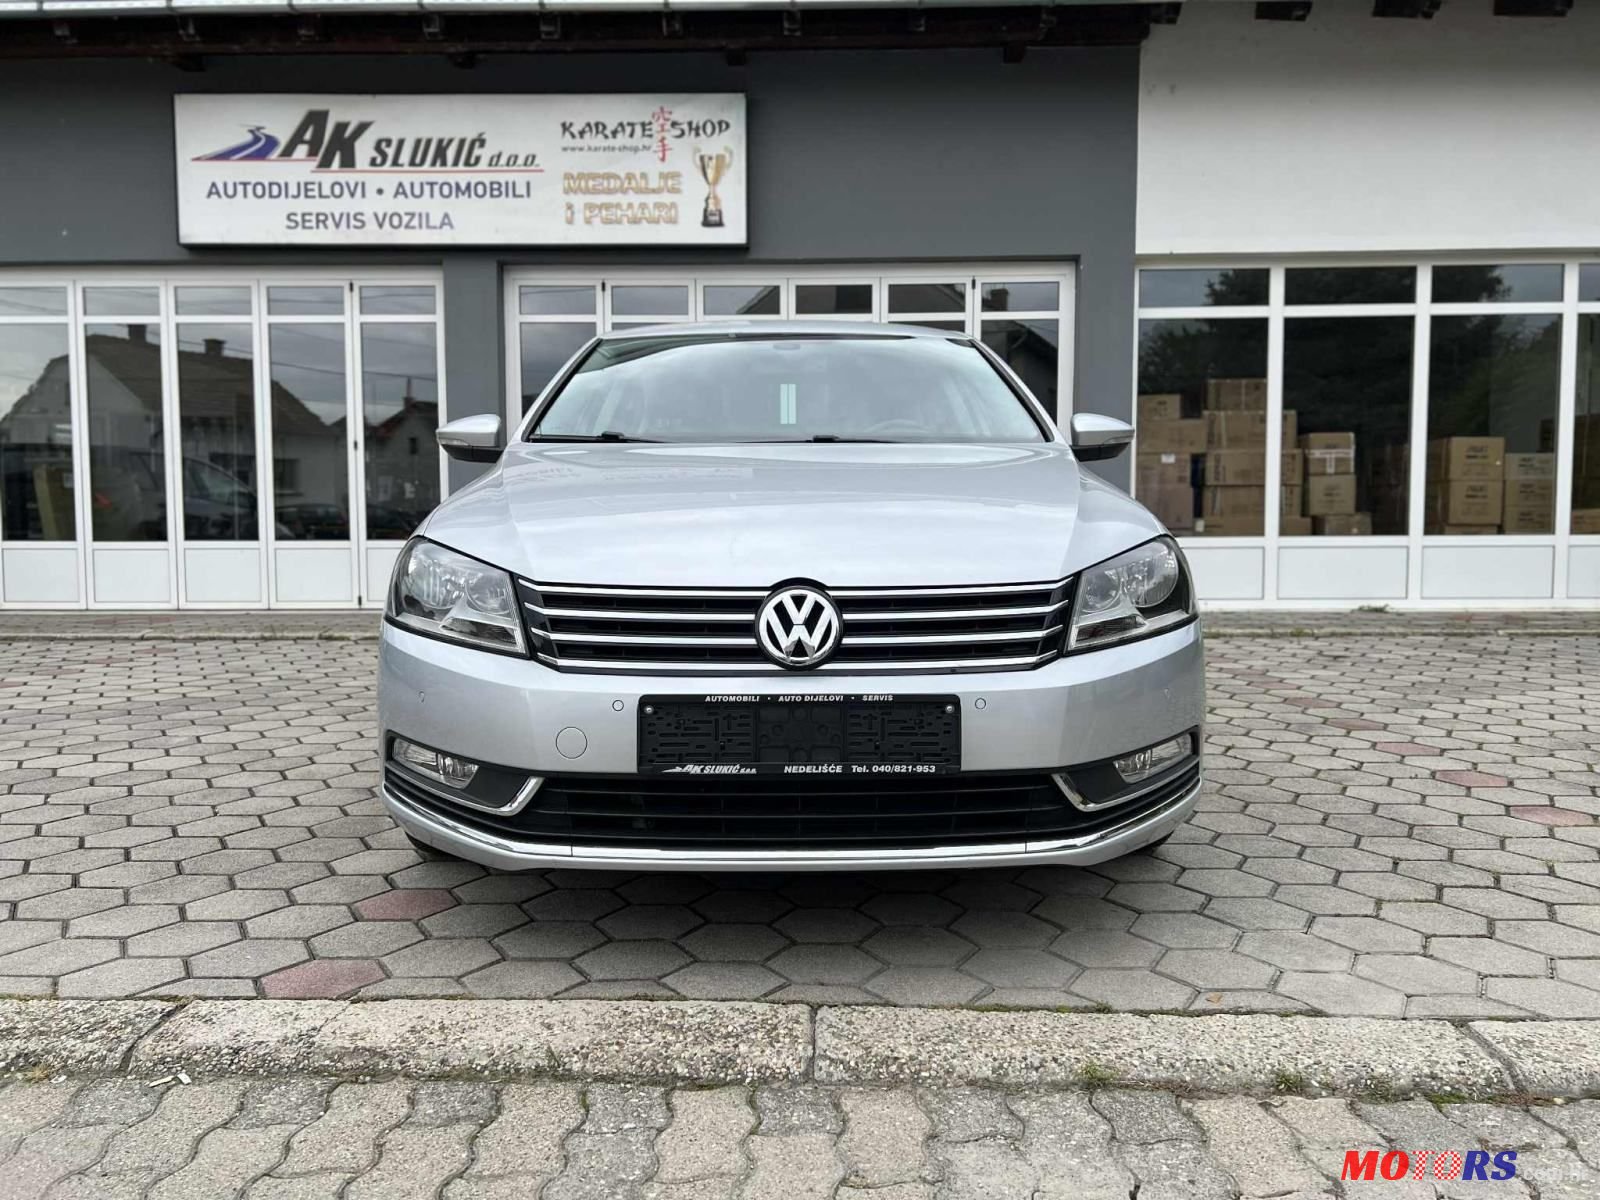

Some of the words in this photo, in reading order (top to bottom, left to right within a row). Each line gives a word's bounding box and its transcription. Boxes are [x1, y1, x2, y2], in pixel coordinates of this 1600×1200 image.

[277, 109, 376, 169] AK
[369, 132, 487, 168] SLUKIĆ
[487, 151, 540, 168] d.o.o.
[560, 120, 654, 139] KARATE
[670, 119, 731, 139] SHOP
[206, 181, 367, 199] AUTODIJELOVI
[393, 180, 532, 199] AUTOMOBILI
[563, 171, 682, 195] MEDALJE
[285, 212, 366, 230] SERVIS
[374, 212, 455, 230] VOZILA
[583, 202, 679, 225] PEHARI
[851, 765, 869, 773] Tel.
[872, 765, 936, 773] 040/821-953
